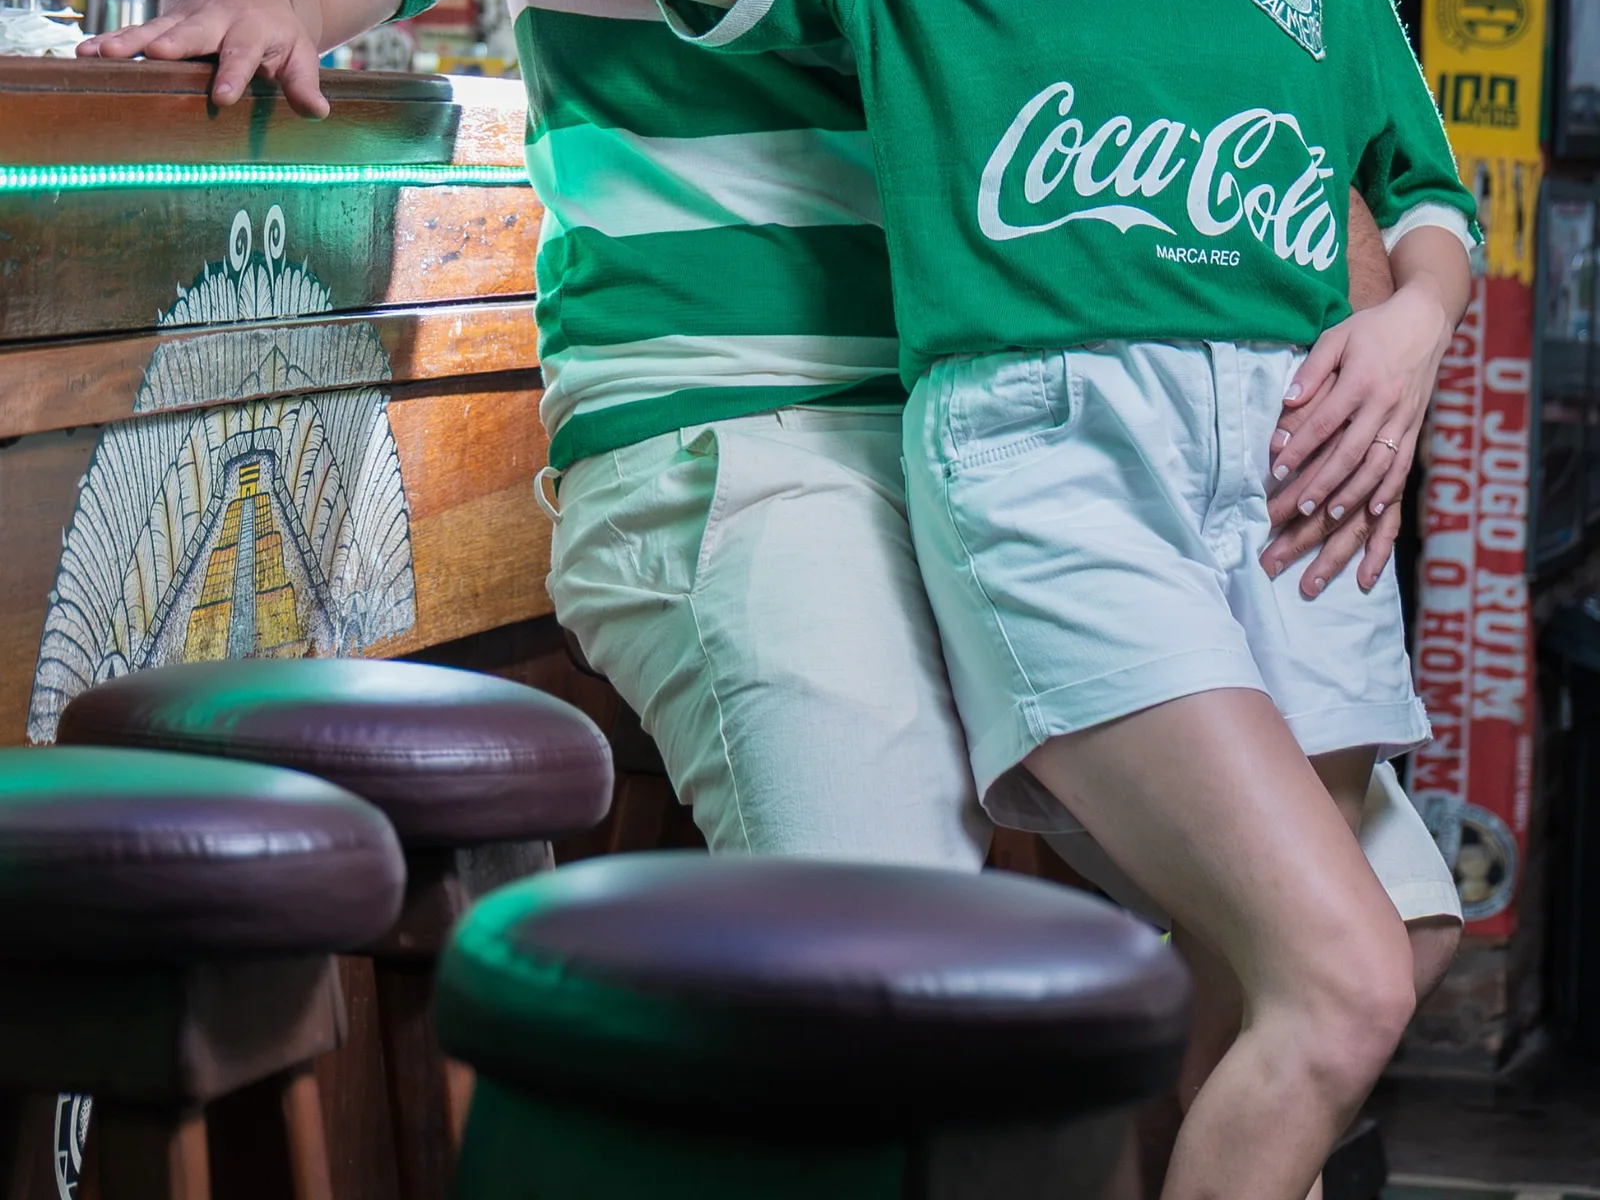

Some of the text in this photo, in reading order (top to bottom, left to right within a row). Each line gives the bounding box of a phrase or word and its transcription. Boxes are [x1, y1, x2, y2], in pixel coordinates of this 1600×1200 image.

[1156, 244, 1240, 267] MARCA REG
[1472, 356, 1533, 726] O JOGO RUIM
